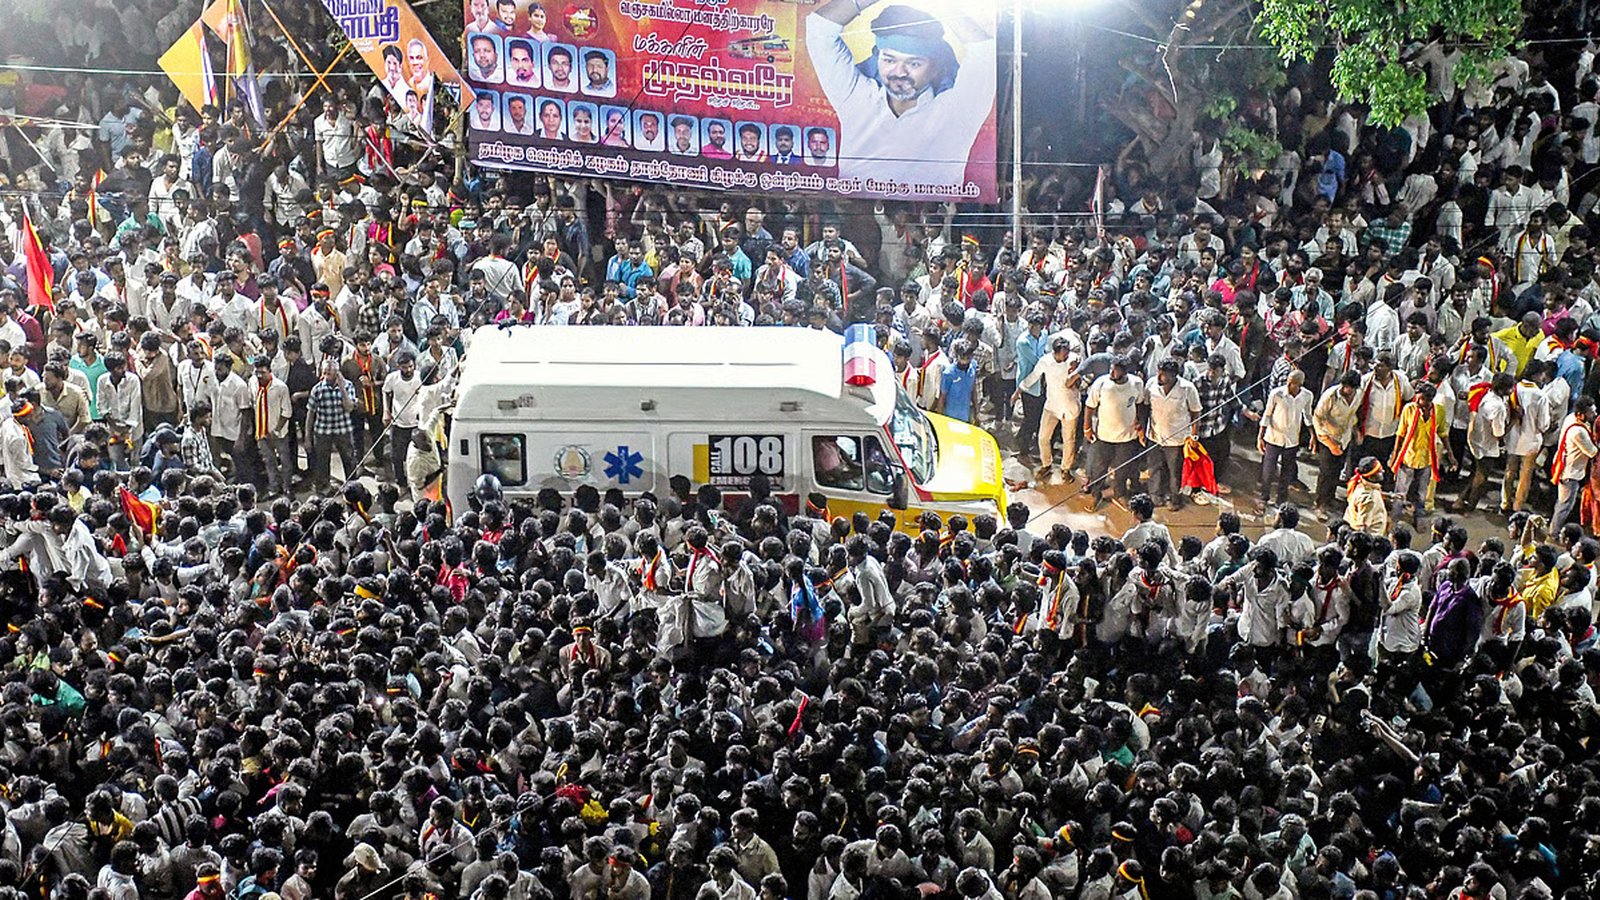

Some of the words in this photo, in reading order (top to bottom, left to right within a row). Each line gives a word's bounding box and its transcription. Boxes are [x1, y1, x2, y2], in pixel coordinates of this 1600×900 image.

[341, 6, 400, 46] ளபதி
[634, 33, 708, 58] மக்களின்
[643, 58, 794, 107] முதல்வரே
[479, 142, 524, 162] தமிழக
[526, 147, 583, 168] வெற்றிக்
[585, 155, 628, 174] கழகம்
[710, 167, 758, 187] கிழக்கு
[710, 446, 722, 474] CALL
[714, 436, 782, 475] 108
